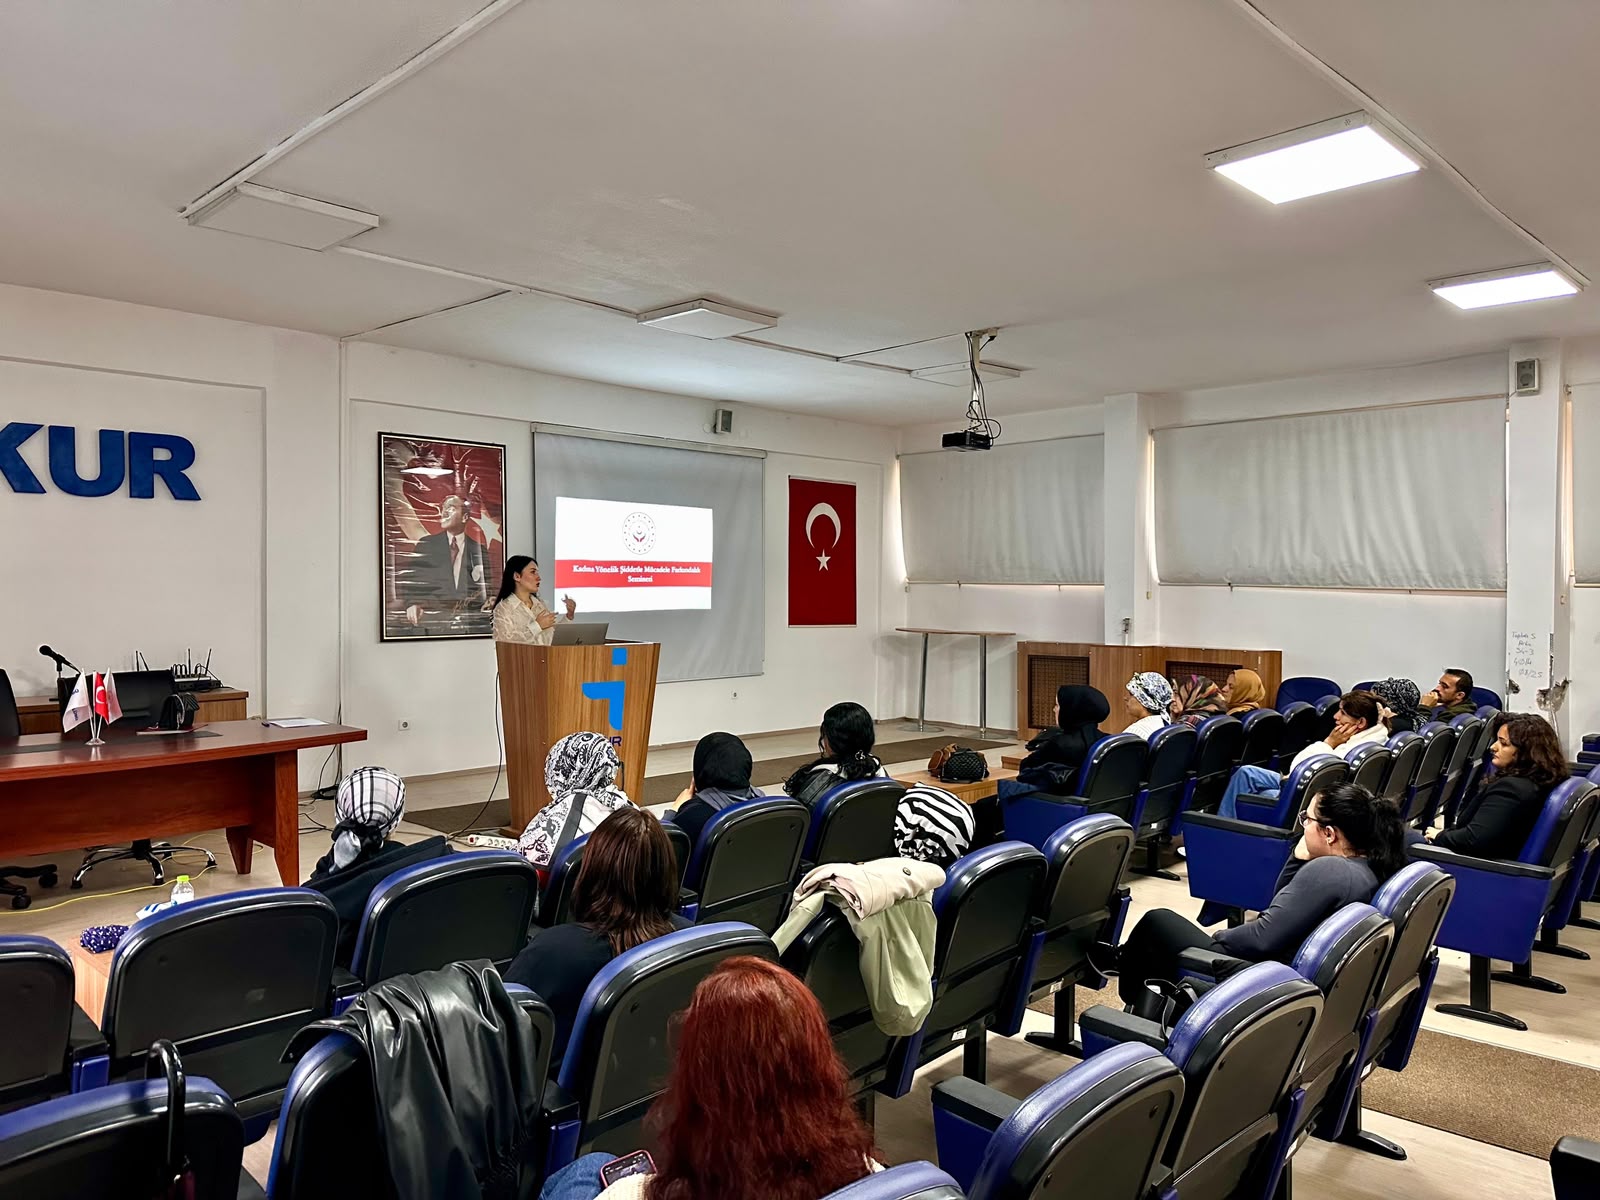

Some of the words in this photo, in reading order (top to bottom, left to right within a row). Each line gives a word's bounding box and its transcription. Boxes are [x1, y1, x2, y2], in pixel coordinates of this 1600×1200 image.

[595, 565, 619, 573] Yönelik
[620, 565, 643, 574] Şiddetle
[644, 565, 670, 573] Mücadele
